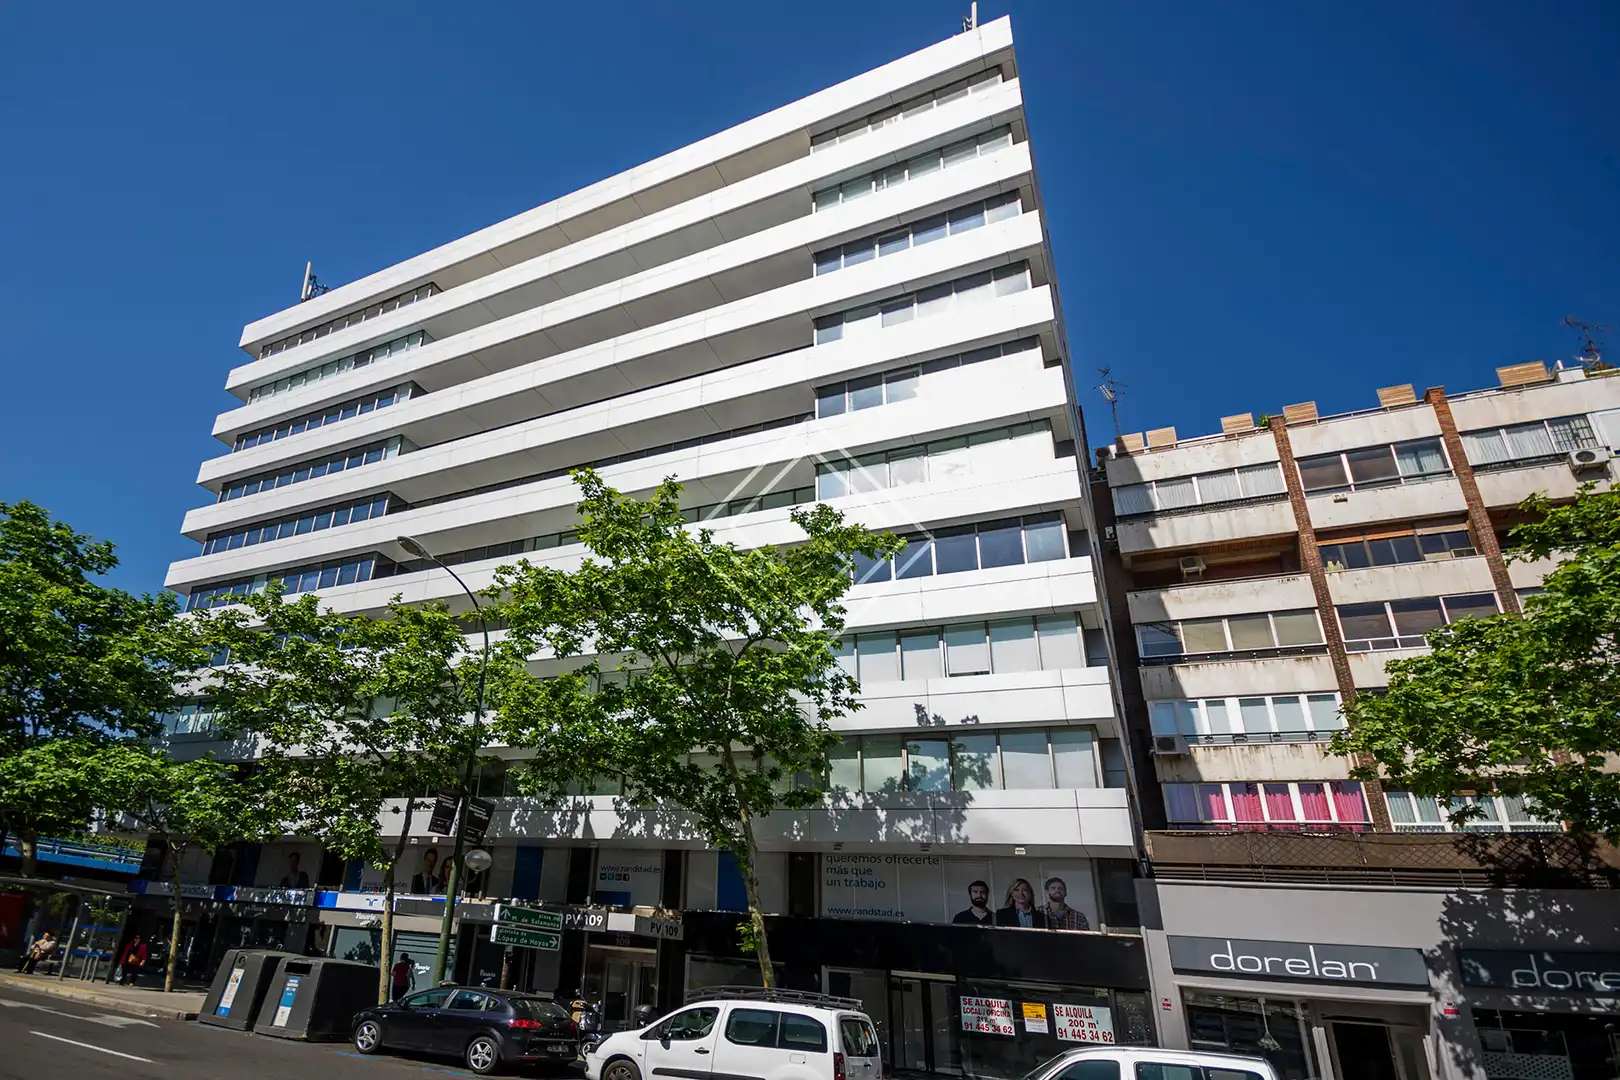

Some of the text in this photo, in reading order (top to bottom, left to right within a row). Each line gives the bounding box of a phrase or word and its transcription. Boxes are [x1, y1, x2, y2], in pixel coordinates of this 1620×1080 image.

[826, 854, 941, 865] queremos ofrecerte
[827, 865, 874, 878] más que
[827, 878, 887, 891] un trabajo
[827, 907, 905, 918] www.randstad.es
[530, 918, 559, 929] Salamanca
[565, 913, 603, 927] PV 109
[664, 924, 679, 937] 109
[530, 938, 549, 947] Hoyos
[1210, 940, 1377, 980] dorelan
[963, 998, 1010, 1009] SE ALQUILA
[963, 1006, 982, 1015] LOCAL
[986, 1009, 1011, 1018] OFICINA
[1055, 1006, 1063, 1017] SE
[1065, 1007, 1093, 1019] ALQUILA
[964, 1021, 1013, 1034] 91 445 34 62
[1068, 1019, 1085, 1028] 200
[1058, 1027, 1114, 1042] 91 445 34 62
